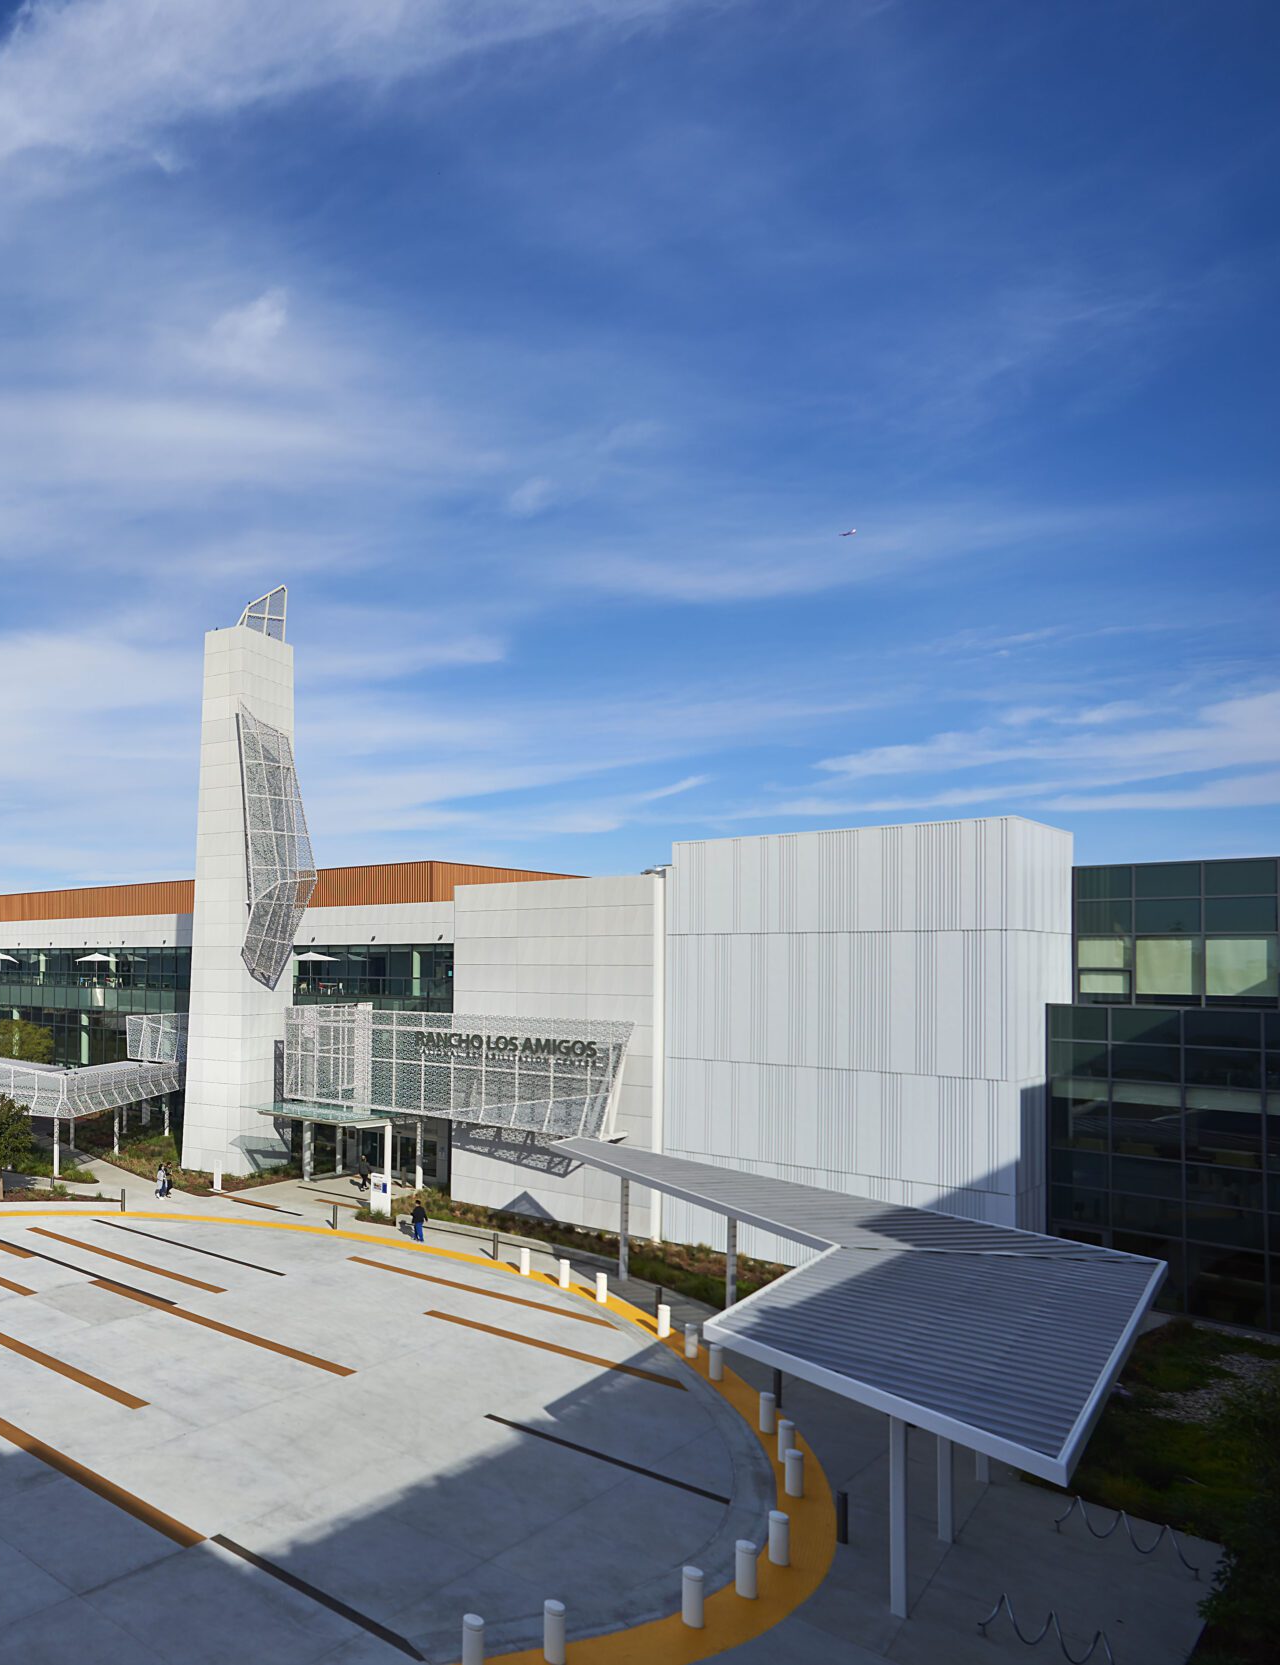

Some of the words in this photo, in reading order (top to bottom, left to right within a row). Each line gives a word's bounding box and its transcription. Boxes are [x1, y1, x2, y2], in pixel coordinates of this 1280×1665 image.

[416, 1031, 483, 1050] RANCHO
[486, 1035, 518, 1053] LOS
[520, 1037, 597, 1058] AMIGOS
